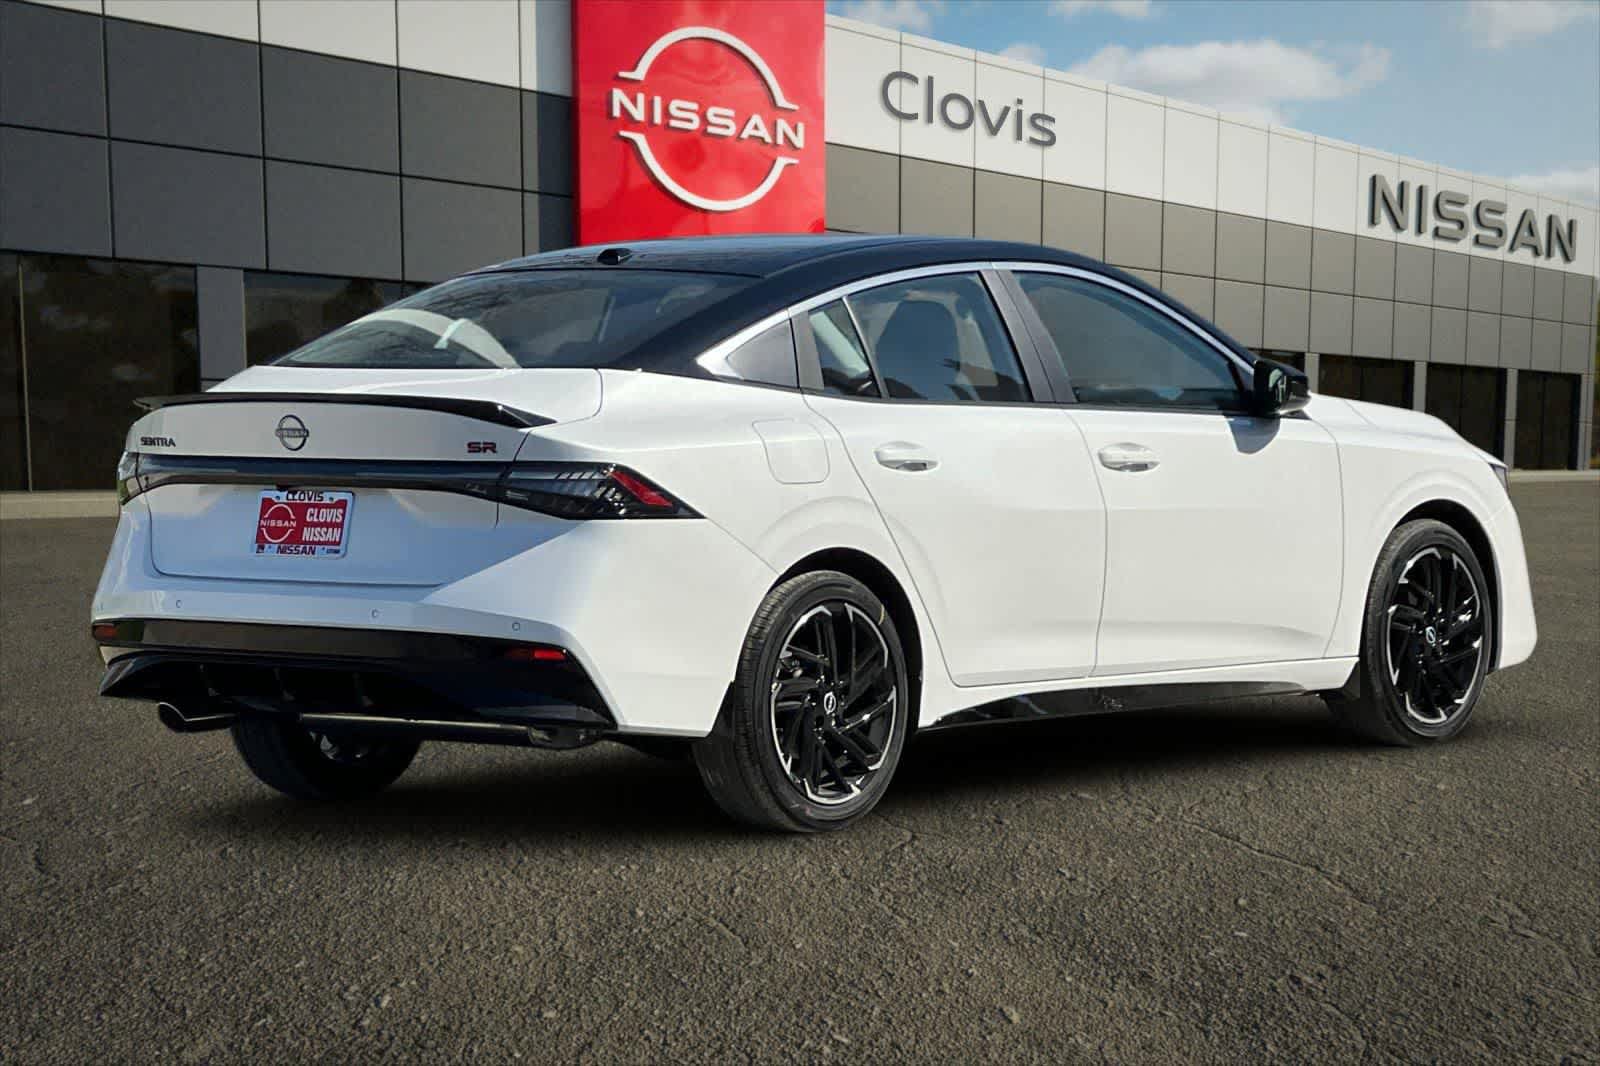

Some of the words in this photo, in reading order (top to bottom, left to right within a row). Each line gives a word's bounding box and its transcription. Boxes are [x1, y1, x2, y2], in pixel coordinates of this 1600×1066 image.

[881, 71, 1057, 148] Clovis
[611, 87, 805, 149] NISSAN
[1368, 174, 1577, 264] NISSAN
[467, 441, 497, 453] SR
[306, 507, 343, 523] CLOVIS
[260, 519, 297, 528] NISSAN
[302, 527, 341, 542] NISSAN
[277, 545, 317, 555] NISSAN
